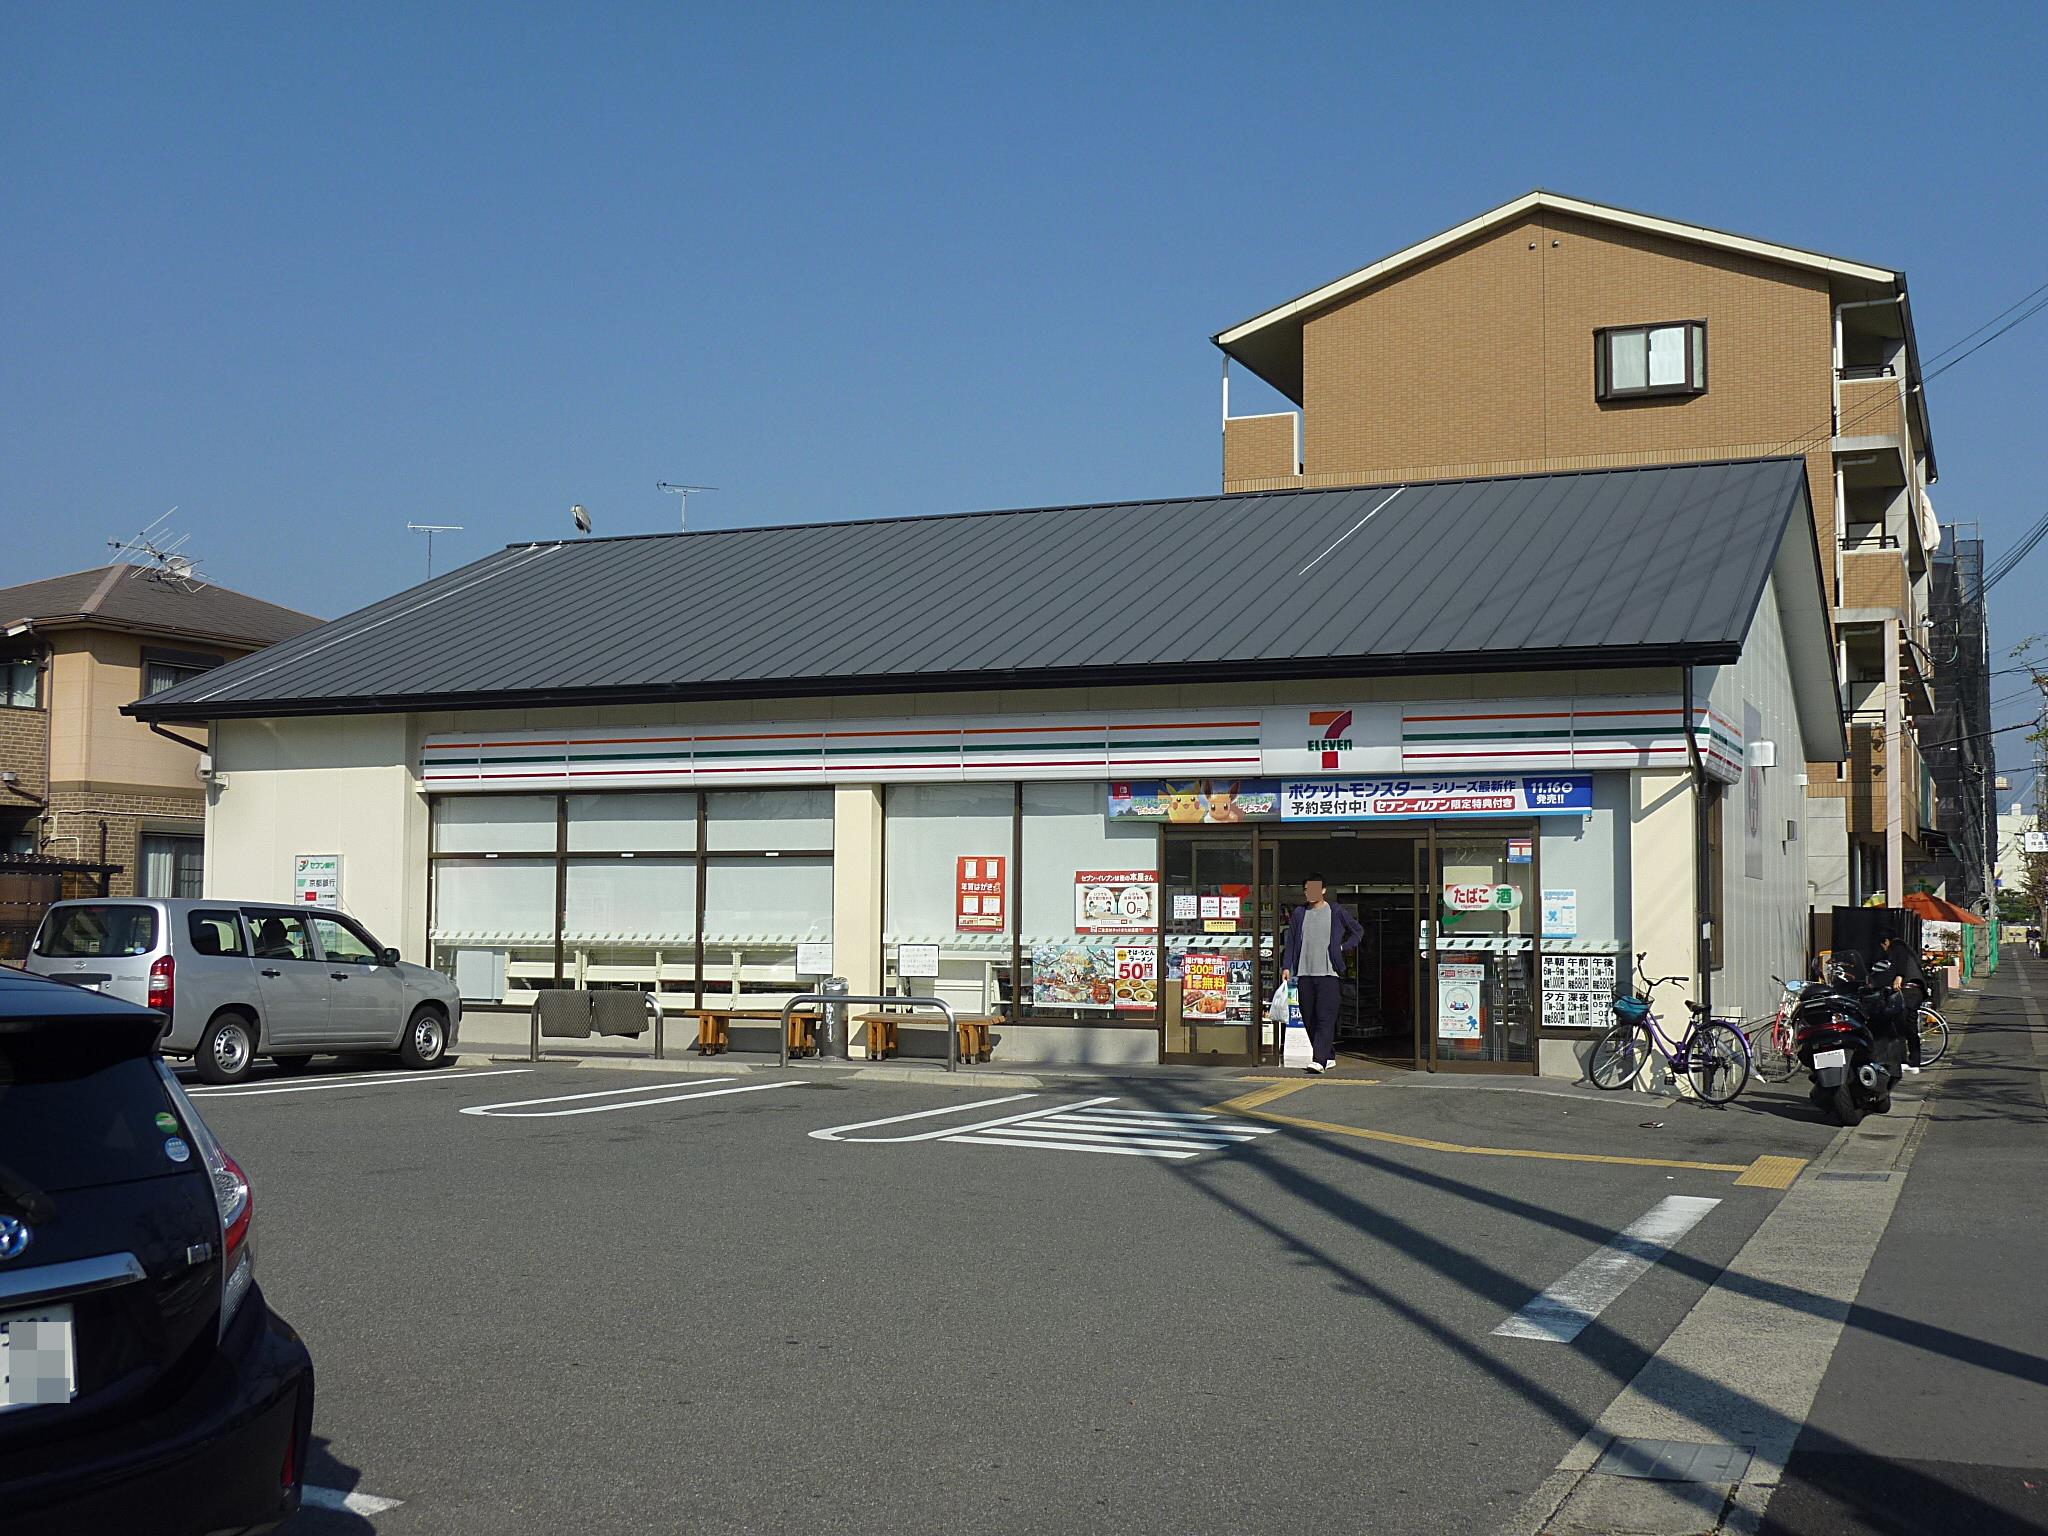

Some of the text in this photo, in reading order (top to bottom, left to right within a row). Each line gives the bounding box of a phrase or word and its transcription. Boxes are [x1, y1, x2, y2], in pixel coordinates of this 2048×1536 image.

[1288, 780, 1516, 800] ポケットモンスター シリーズ最新作
[1291, 800, 1367, 815] 予約受付中!
[309, 879, 336, 888] 京都銀行
[1454, 888, 1489, 903] たばこ
[1496, 888, 1512, 903] 酒
[1230, 962, 1252, 970] GLAY
[1544, 957, 1565, 966] 早朝
[1567, 958, 1589, 967] 午前
[1592, 958, 1614, 967] 午後
[1544, 992, 1566, 1002] 夕方
[1567, 993, 1590, 1002] 深夜
